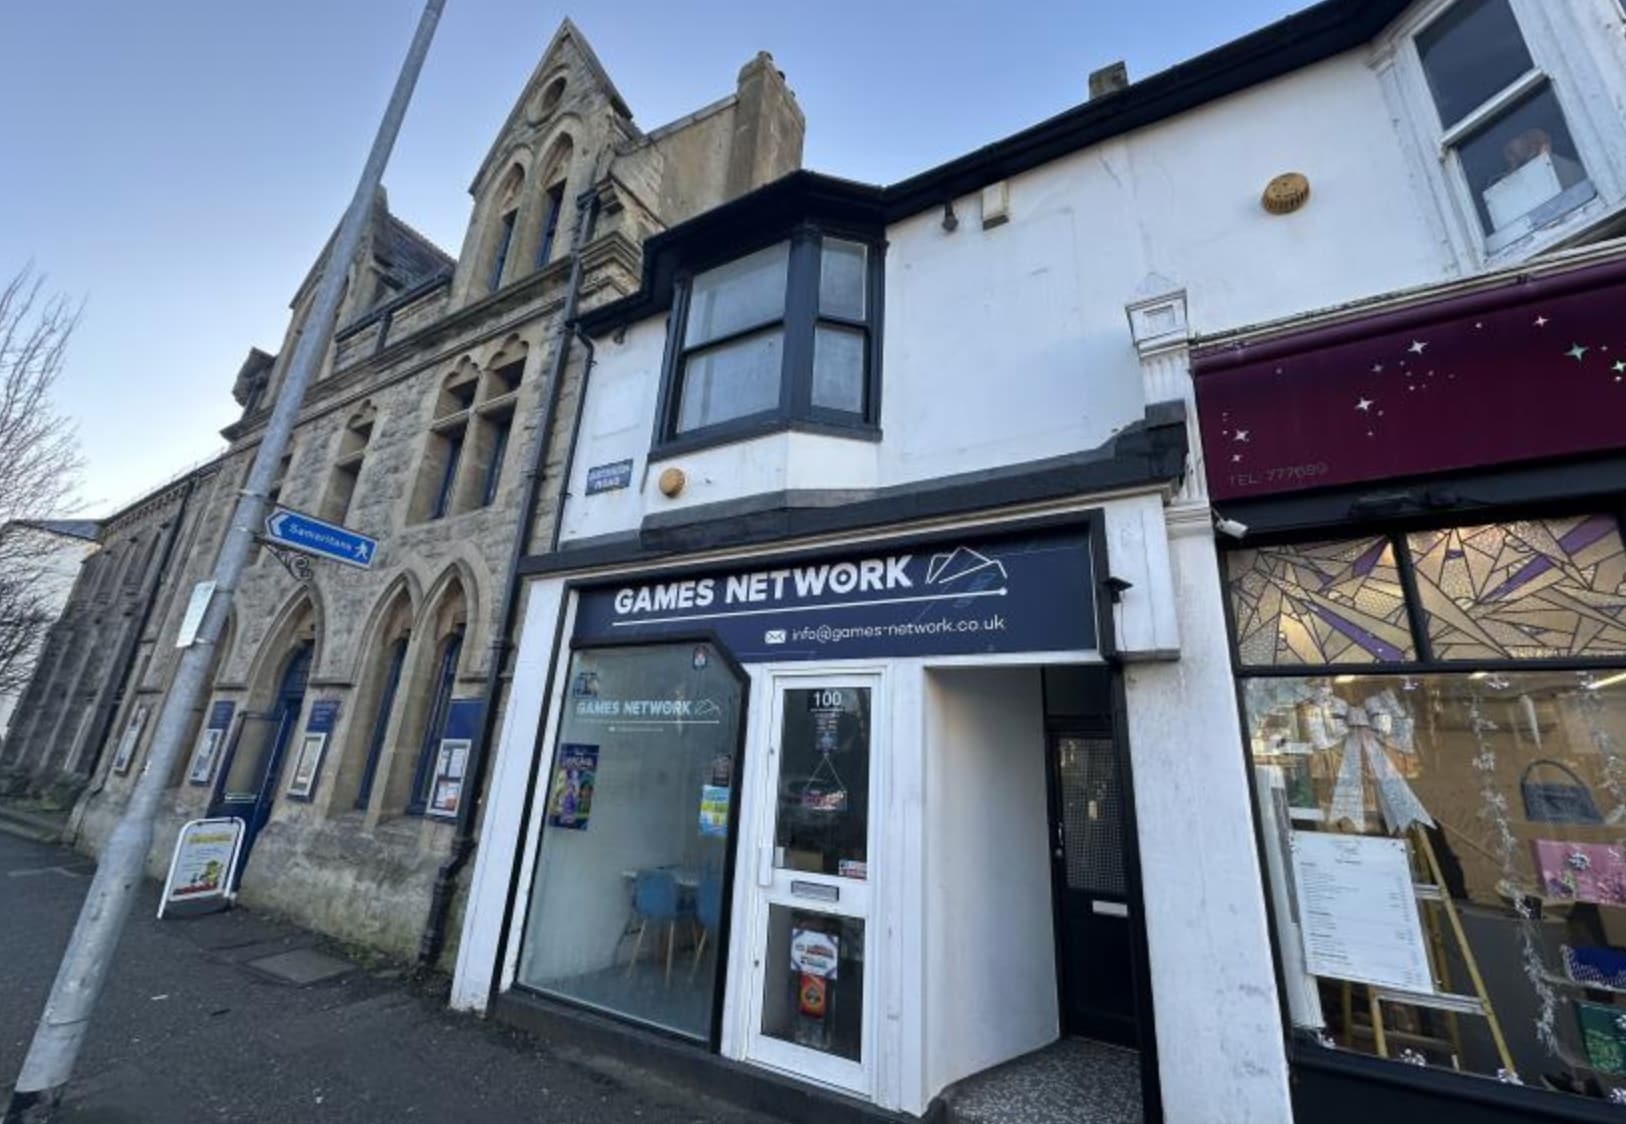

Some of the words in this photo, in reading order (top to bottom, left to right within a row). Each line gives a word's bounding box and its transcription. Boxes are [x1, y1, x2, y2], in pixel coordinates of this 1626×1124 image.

[288, 522, 353, 552] Samaritans
[613, 578, 715, 614] GAMES
[724, 554, 914, 604] NETWORK
[791, 614, 1006, 643] info@games-network.co.uk
[576, 701, 619, 715] GAMES
[623, 701, 692, 715] NETWORK
[813, 691, 842, 707] 100
